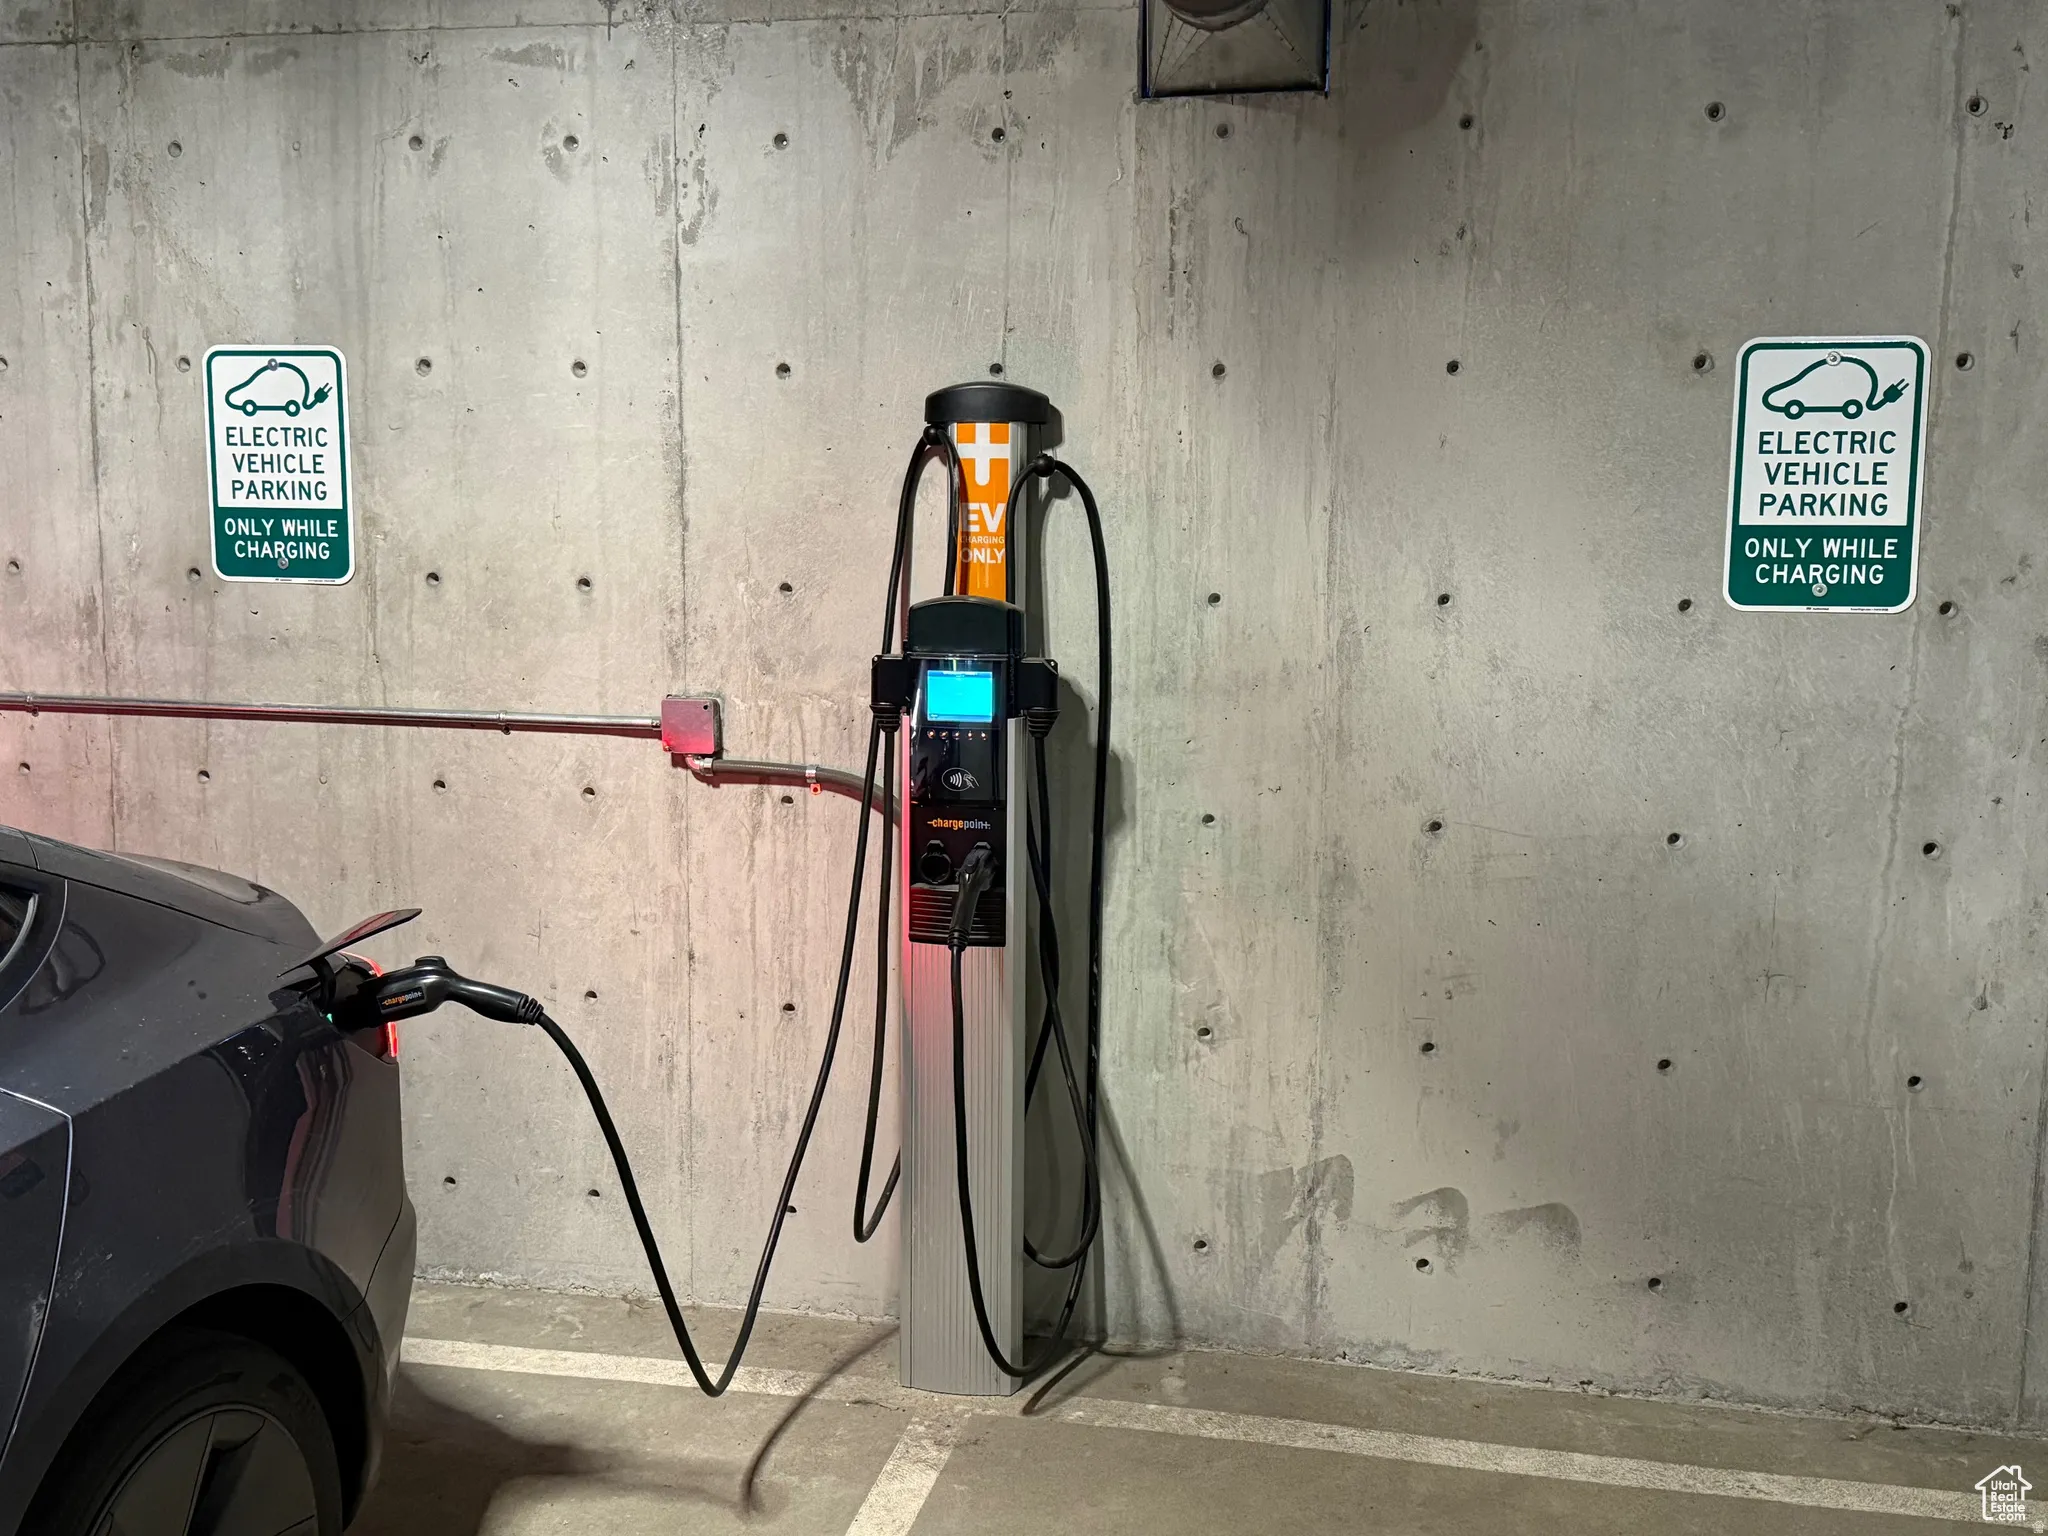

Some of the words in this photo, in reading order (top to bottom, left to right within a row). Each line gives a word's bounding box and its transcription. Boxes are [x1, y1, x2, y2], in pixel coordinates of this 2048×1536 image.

[226, 426, 328, 447] ELECTRIC
[1758, 430, 1897, 455] ELECTRIC
[232, 453, 325, 474] VEHICLE
[1764, 462, 1889, 486] VEHICLE
[231, 480, 327, 501] PARKING
[1759, 492, 1888, 517] PARKING
[224, 518, 274, 536] ONLY
[282, 519, 338, 538] WHILE
[960, 502, 1006, 533] EV
[234, 540, 330, 560] CHARGING
[959, 535, 1005, 545] CHARGING
[1744, 537, 1813, 559] ONLY
[1822, 538, 1898, 559] WHILE
[960, 547, 1006, 564] ONLY
[1755, 563, 1884, 585] CHARGING
